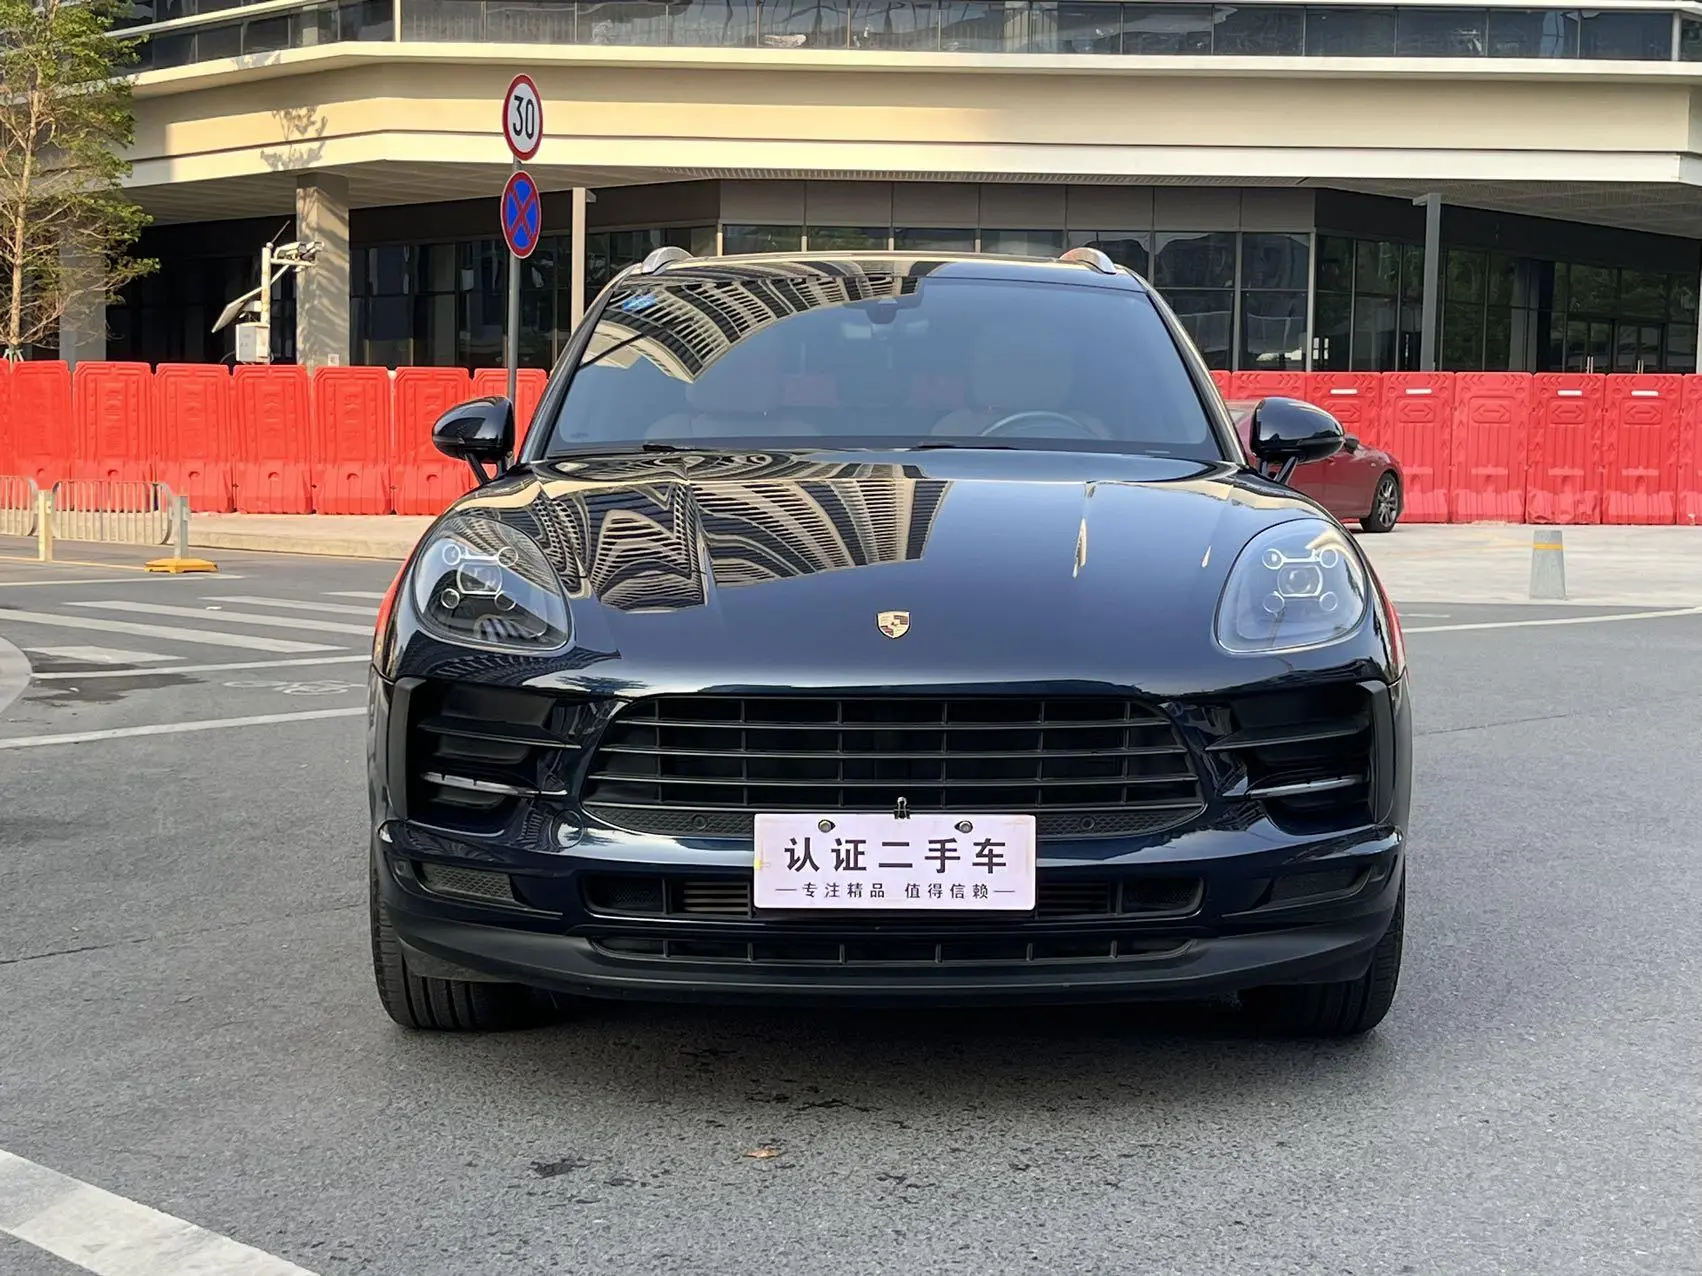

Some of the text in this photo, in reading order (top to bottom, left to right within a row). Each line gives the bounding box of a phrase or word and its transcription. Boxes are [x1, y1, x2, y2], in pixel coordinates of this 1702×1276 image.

[513, 94, 535, 140] 30
[784, 837, 1007, 874] 认证二手车
[802, 882, 989, 900] 专注精品 值得信赖
